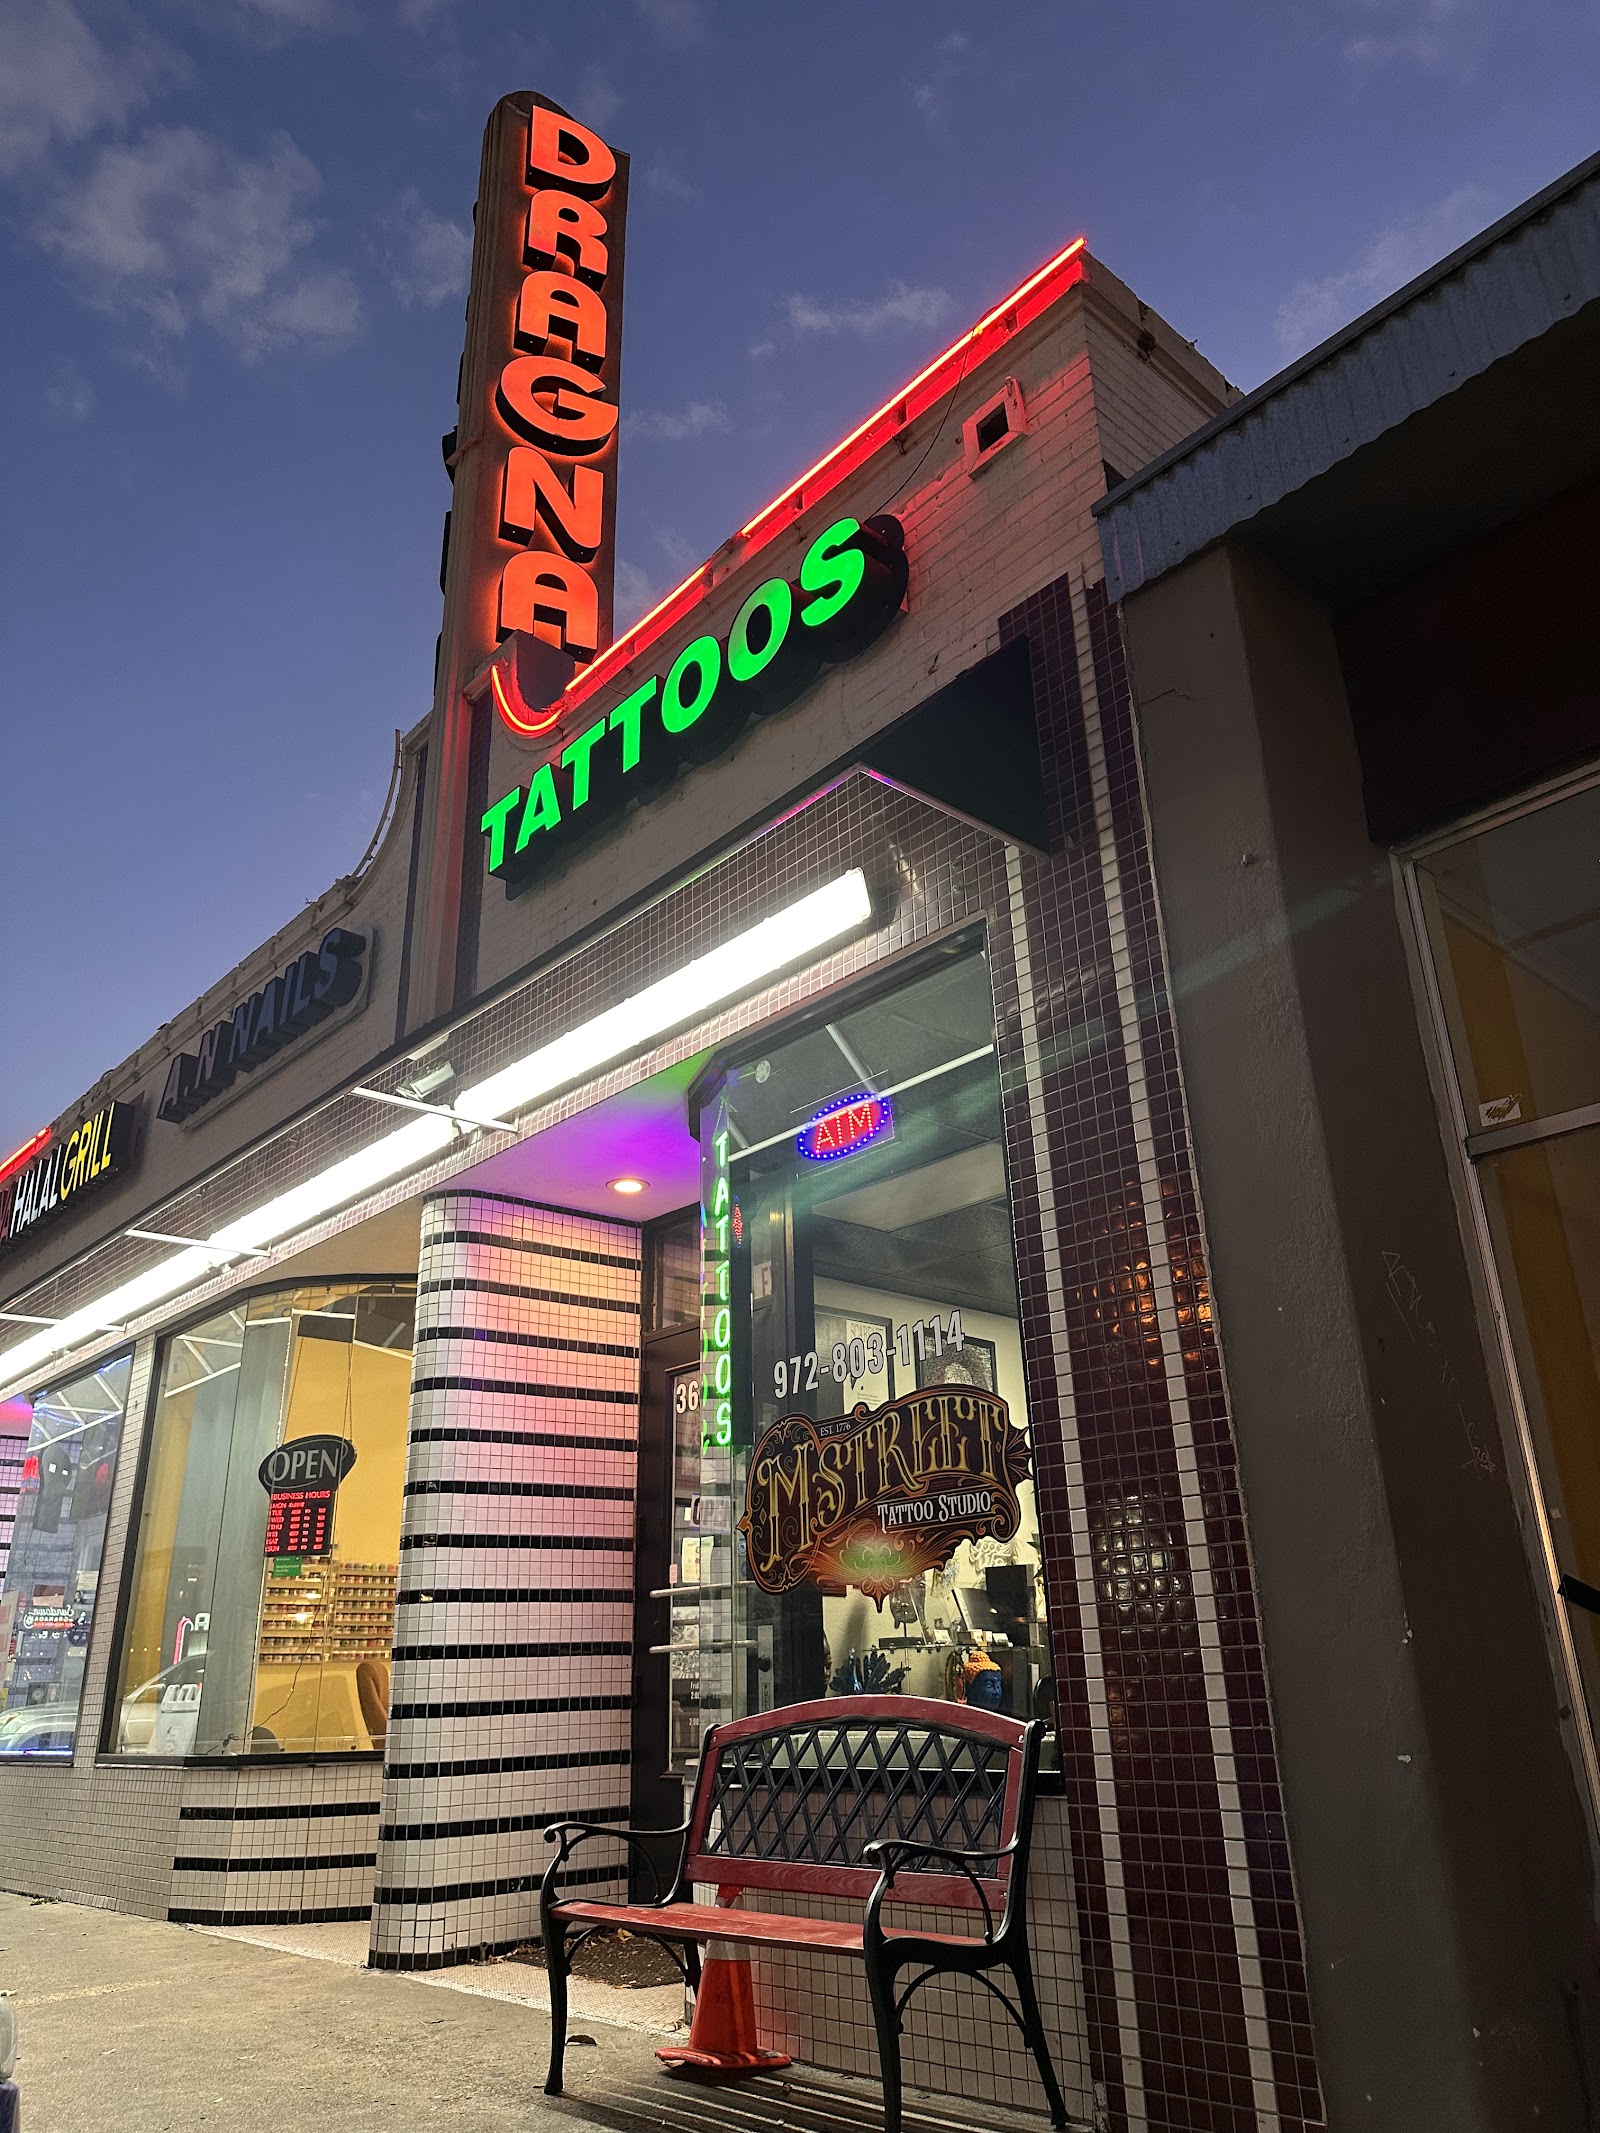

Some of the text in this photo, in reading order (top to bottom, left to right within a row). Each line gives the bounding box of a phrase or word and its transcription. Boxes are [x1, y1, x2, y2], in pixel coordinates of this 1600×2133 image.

[500, 104, 618, 650] DRAGNA
[481, 518, 866, 873] TATTOOS
[228, 928, 344, 1066] NAILS
[10, 1144, 62, 1238] HALAL
[60, 1101, 115, 1201] GRILL
[816, 1100, 874, 1153] ATM
[713, 1130, 732, 1446] TATTOOS
[773, 1309, 965, 1399] 972-803-1114
[268, 1448, 340, 1482] OPEN
[271, 1490, 331, 1500] BUSINESS HOURS
[877, 1491, 991, 1534] TATTOO STUDIO
